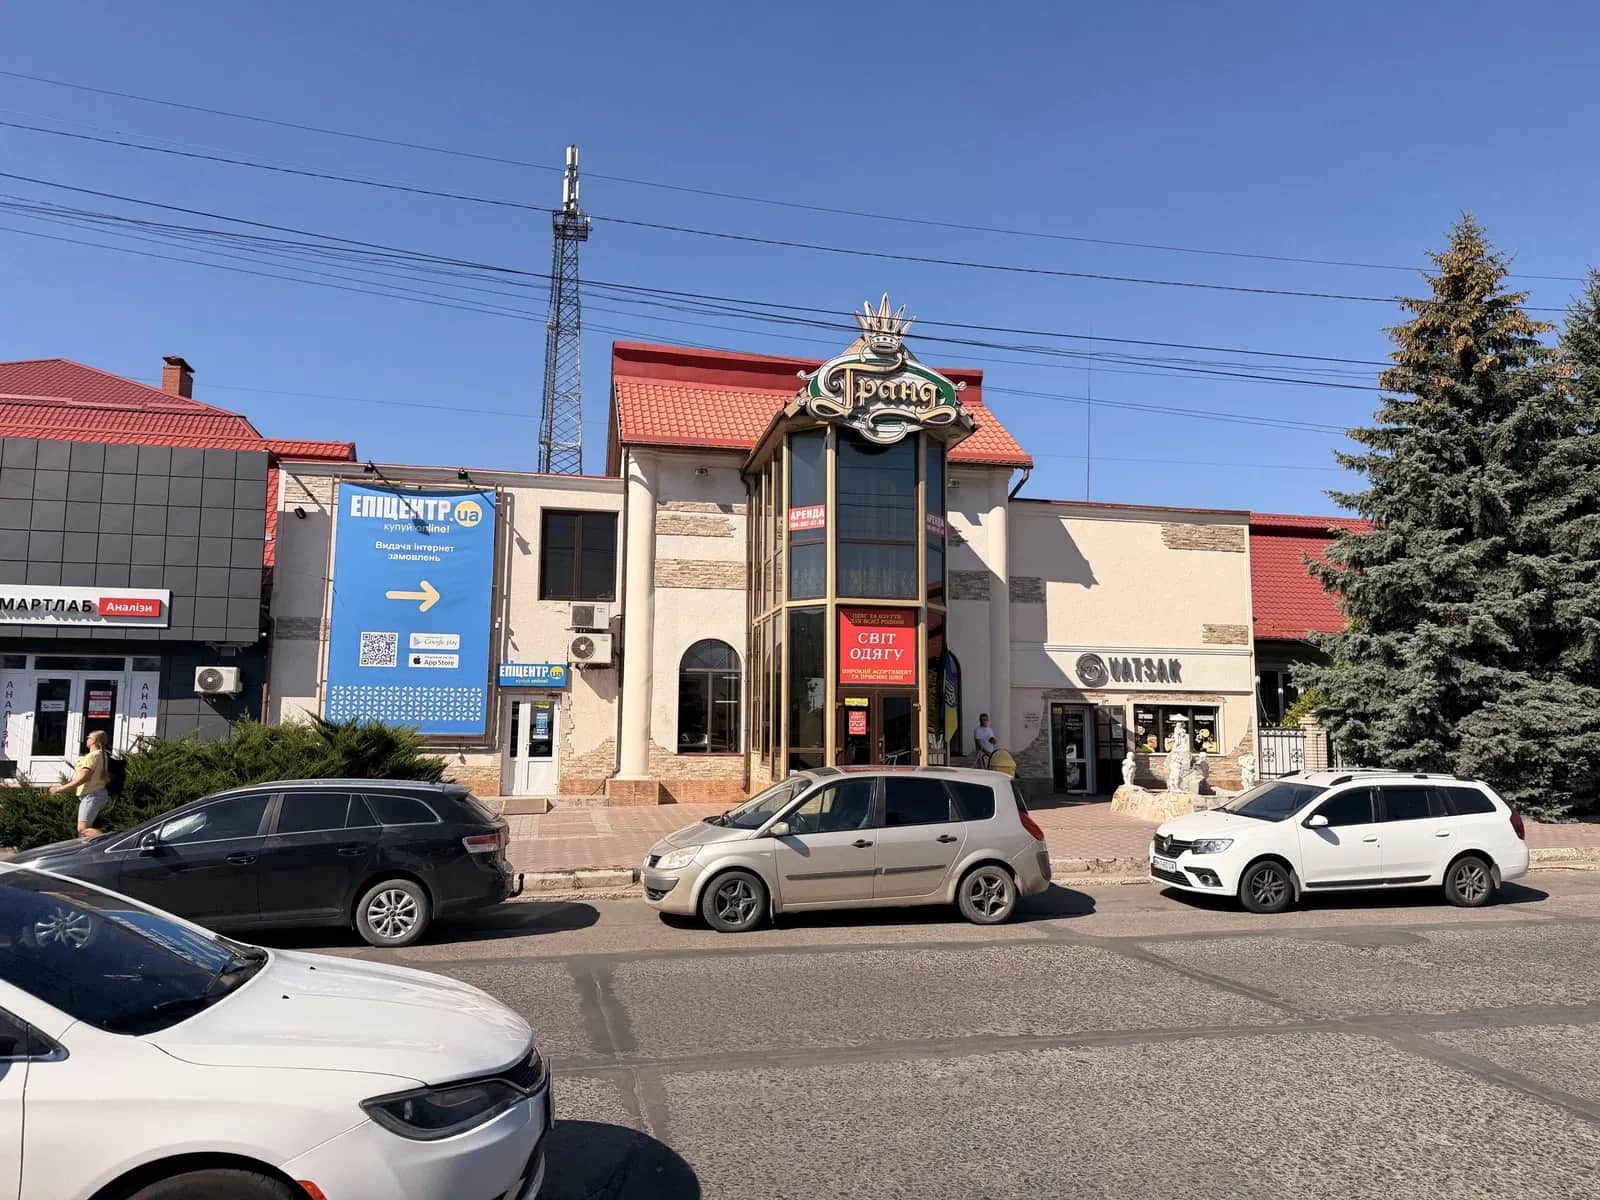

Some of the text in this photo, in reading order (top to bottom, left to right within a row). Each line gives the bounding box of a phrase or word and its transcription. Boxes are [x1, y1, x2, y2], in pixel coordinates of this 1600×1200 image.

[824, 359, 940, 412] Гранд
[790, 508, 825, 521] АРЕНДА
[383, 523, 450, 534] купуй online!
[375, 541, 456, 554] Видача інтернет
[387, 552, 441, 562] замовлень
[0, 597, 92, 612] МАРТЛАБ
[105, 602, 153, 612] Аналізи
[857, 632, 897, 645] СВІТ
[849, 647, 905, 661] ОДЯГУ
[1108, 657, 1182, 684] VATSAK
[1, 680, 14, 749] АНАЛІЗИ
[138, 682, 150, 737] АНАЛІ
